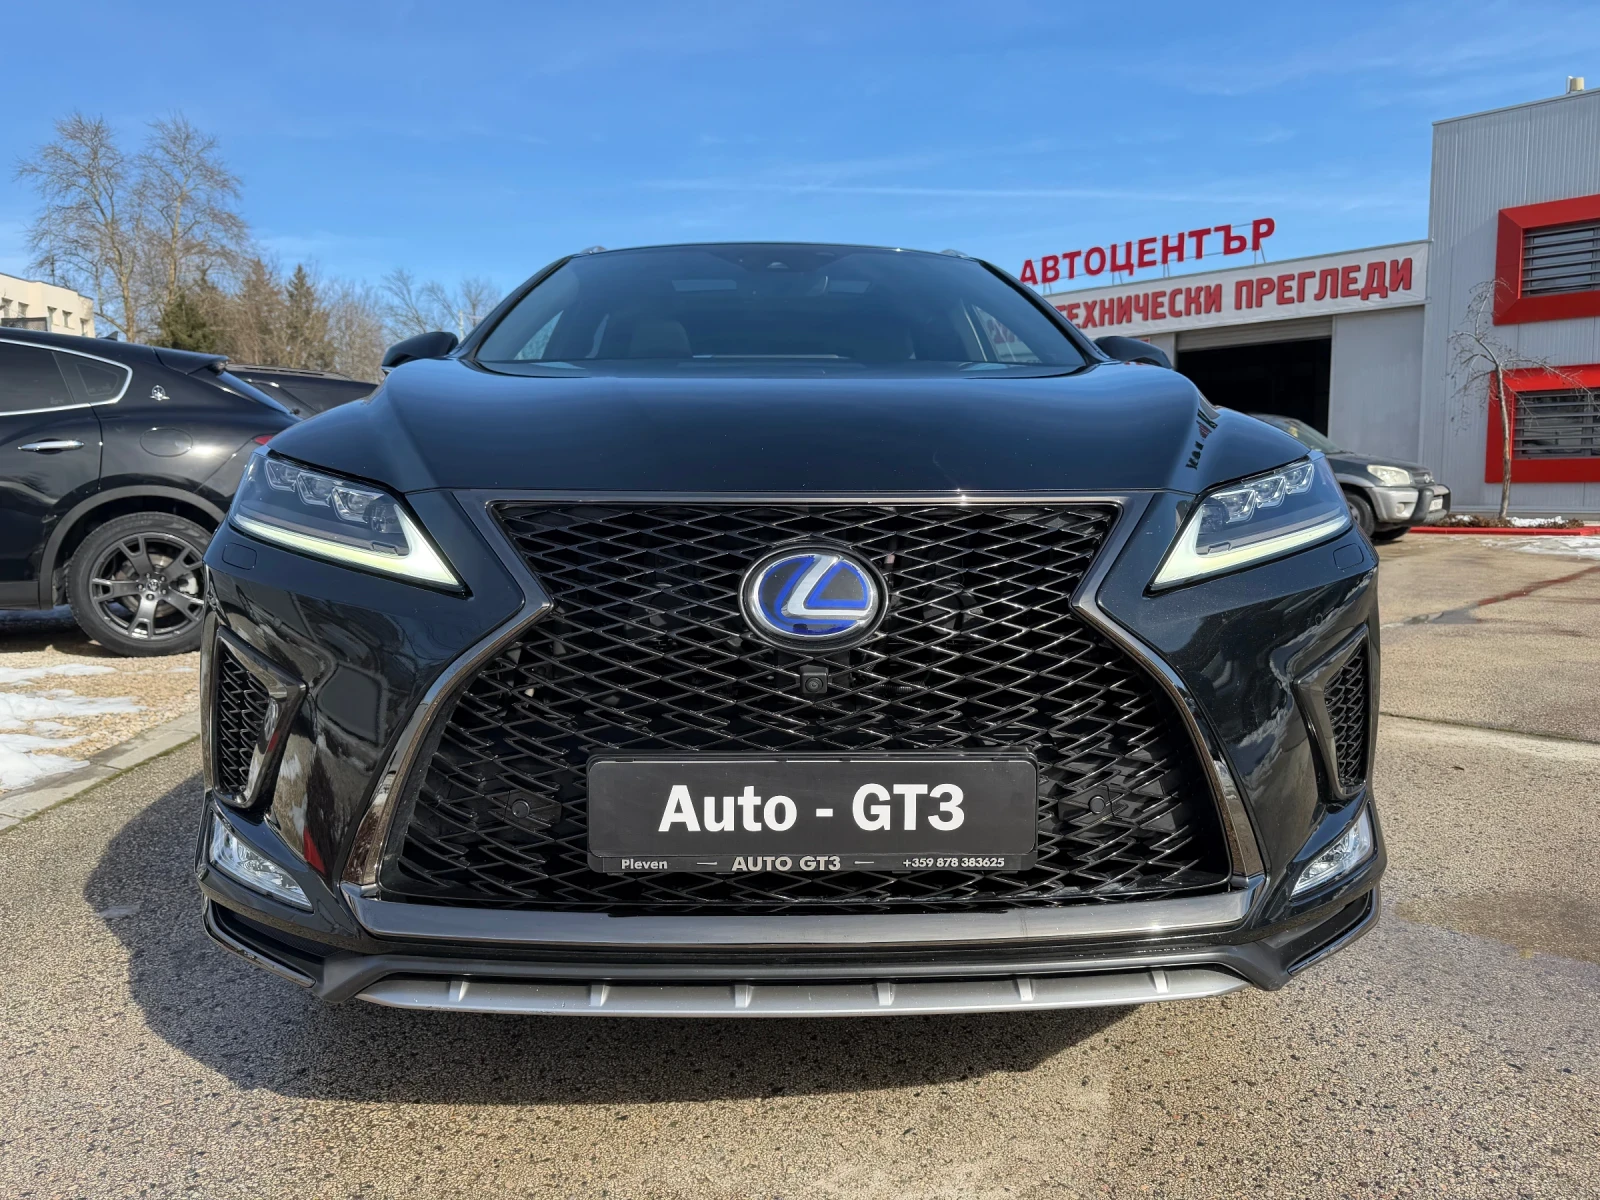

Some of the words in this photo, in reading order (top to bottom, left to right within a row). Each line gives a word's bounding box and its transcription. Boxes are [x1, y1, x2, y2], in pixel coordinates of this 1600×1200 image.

[1020, 217, 1276, 285] АВТОЦЕНТЪР
[1234, 257, 1413, 311] ПРЕГЛЕДИ
[657, 784, 798, 833] Auto
[851, 782, 966, 832] GT3
[621, 858, 668, 870] Pleven
[731, 855, 793, 872] AUTO
[799, 855, 841, 871] GT3
[902, 857, 933, 868] +359
[935, 857, 959, 868] 878
[961, 857, 1005, 868] 383625
